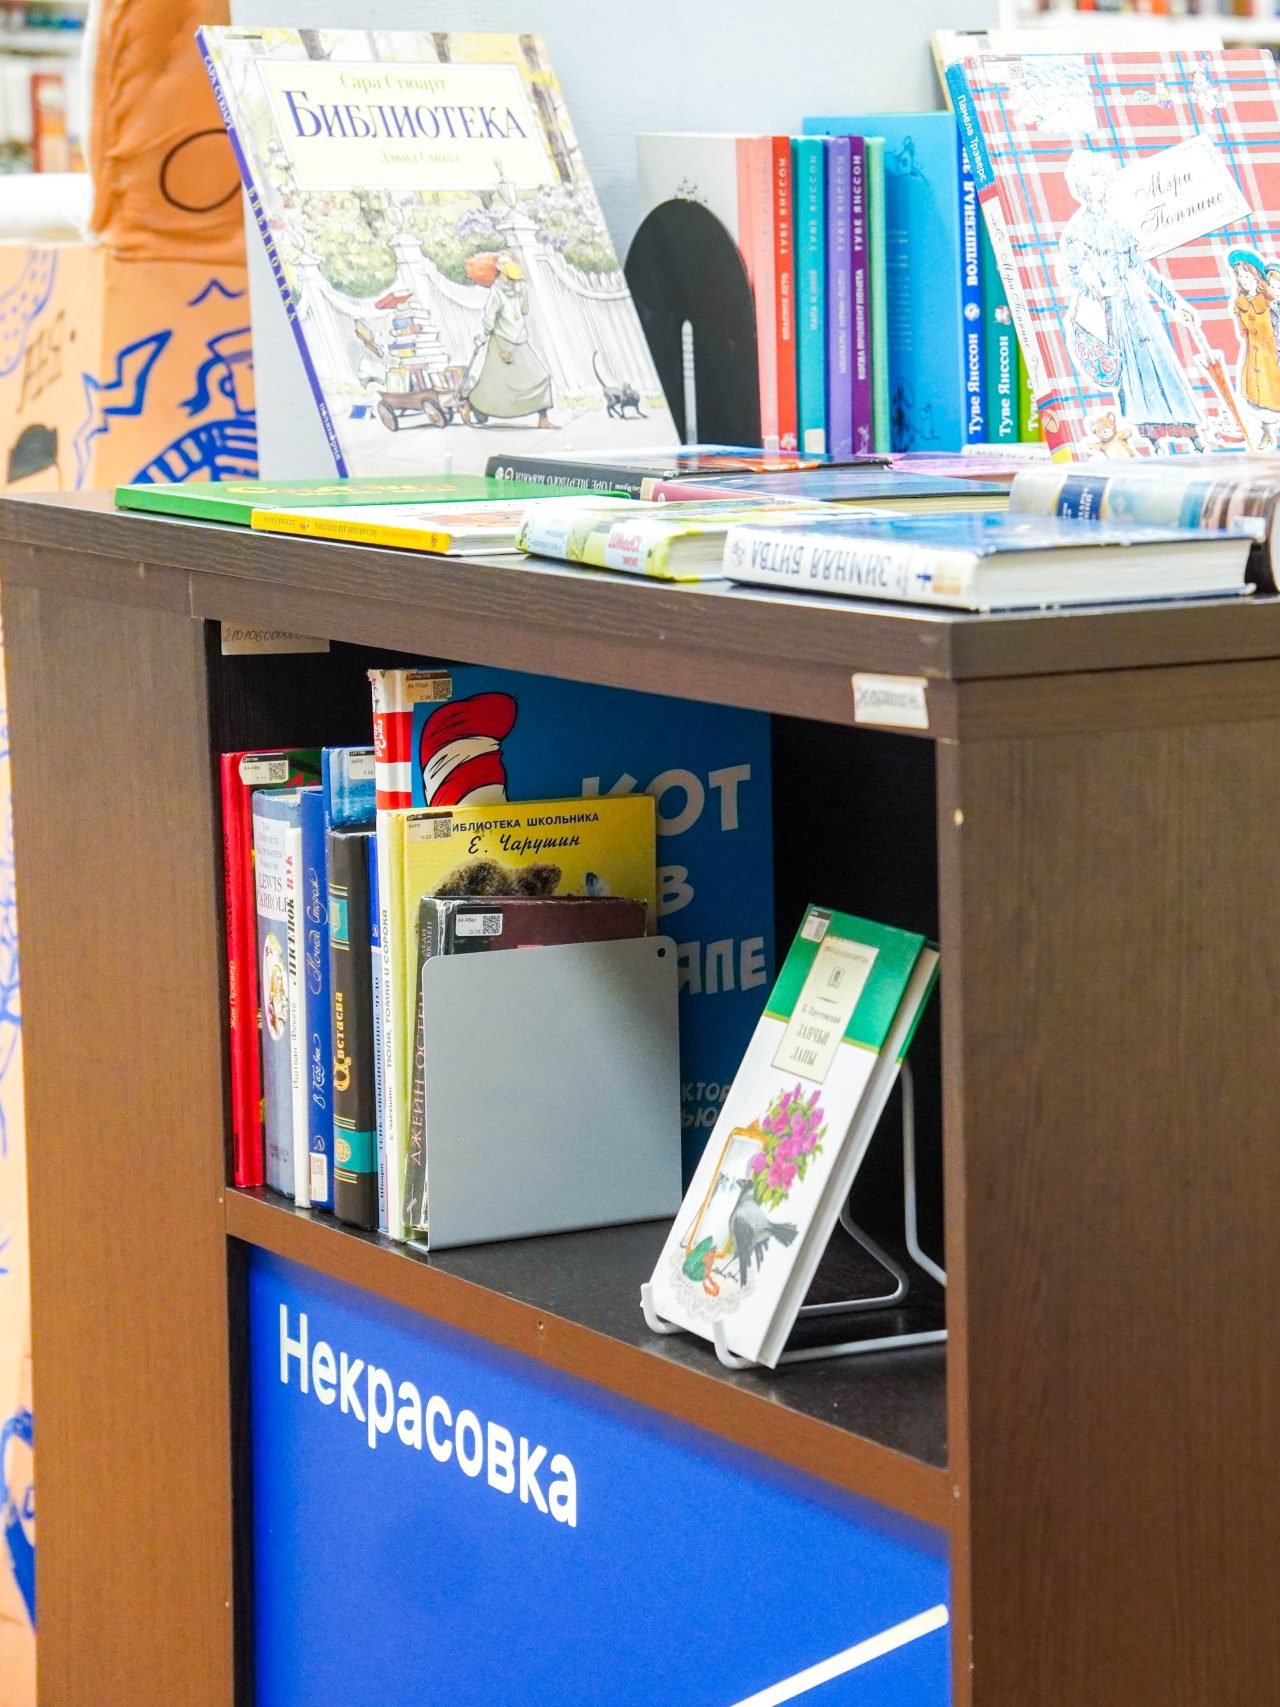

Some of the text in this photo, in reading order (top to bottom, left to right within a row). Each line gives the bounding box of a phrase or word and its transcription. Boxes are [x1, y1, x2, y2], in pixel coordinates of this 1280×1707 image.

[339, 72, 448, 94] Сара Стюарт
[957, 95, 988, 183] Памела Трэверс
[852, 155, 863, 252] ТУВЕ ЯНССОН
[1135, 171, 1223, 234] Мэри Поппинс
[779, 222, 789, 254] ТУВЕ
[963, 181, 984, 435] Туве Янссон ВОЛШЕБНАЯ
[997, 335, 1012, 437] Туве Янссон
[750, 540, 804, 575] БИТВА
[809, 548, 892, 587] ЗИМНЯЯ
[452, 813, 600, 832] ИБЛИОТЕКА ШКОЛЬНИКА
[499, 834, 581, 856] Чарушин
[258, 872, 283, 893] LEWIS
[657, 864, 695, 917] В
[382, 909, 390, 964] СОРОКА
[677, 936, 767, 996] ЯПЕ
[384, 979, 393, 1024] ТОМКА
[333, 991, 352, 1092] Цветаева
[790, 1046, 819, 1067] ЛАПЫ
[796, 1022, 831, 1046] ЗАЯЧЬИ
[292, 1047, 300, 1089] Иштван
[409, 1079, 424, 1166] ДЖЕЙН
[279, 1302, 578, 1528] Некрасовка
